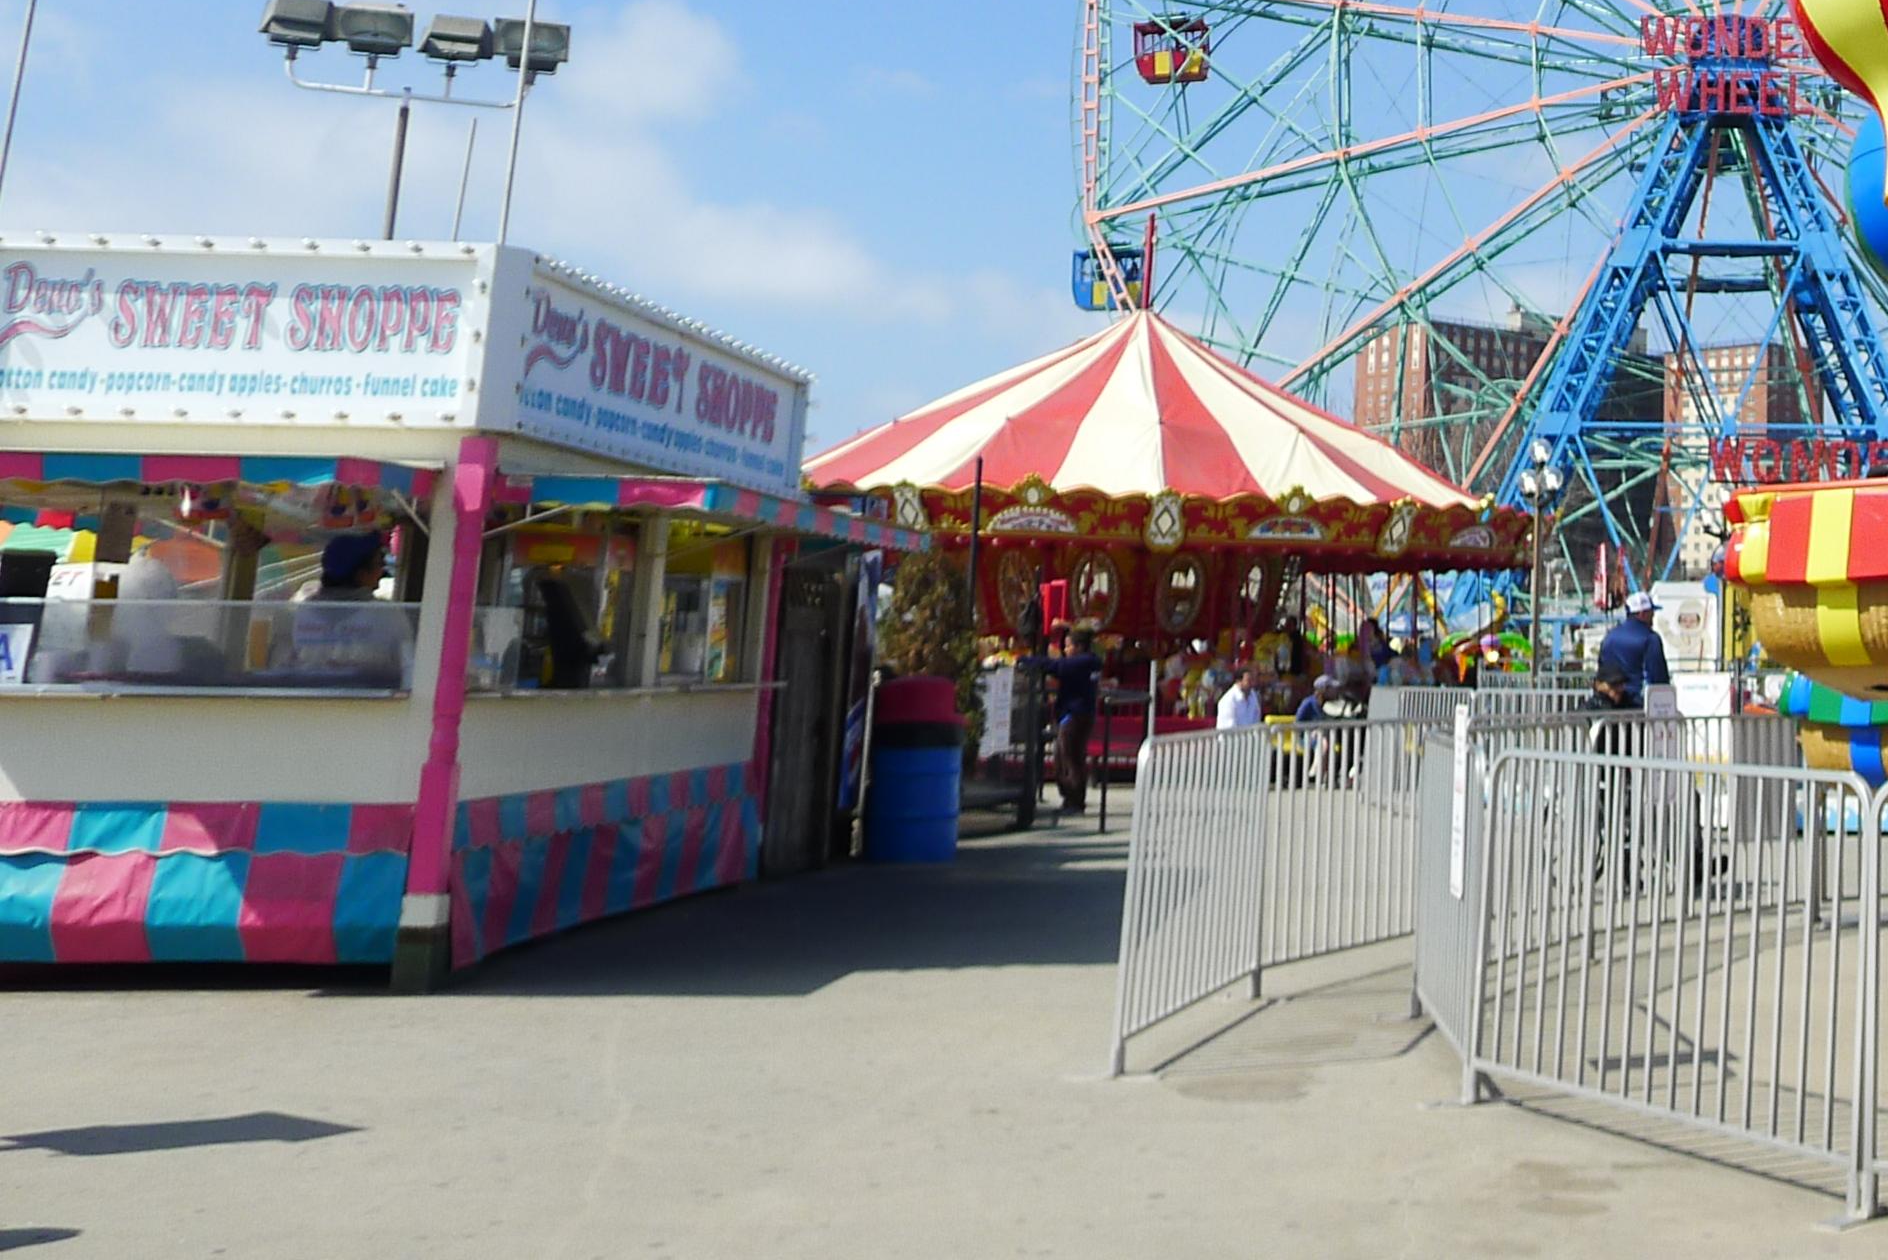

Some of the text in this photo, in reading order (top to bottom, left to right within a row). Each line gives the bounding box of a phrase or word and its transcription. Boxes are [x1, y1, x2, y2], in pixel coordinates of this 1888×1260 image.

[1640, 15, 1808, 59] WONDE
[1653, 68, 1815, 115] WHEEL
[108, 278, 278, 351] SWEET
[286, 282, 462, 354] SHOPPE
[420, 373, 459, 397] cake
[590, 317, 691, 415] SWEET
[695, 359, 779, 446] SHOPPE
